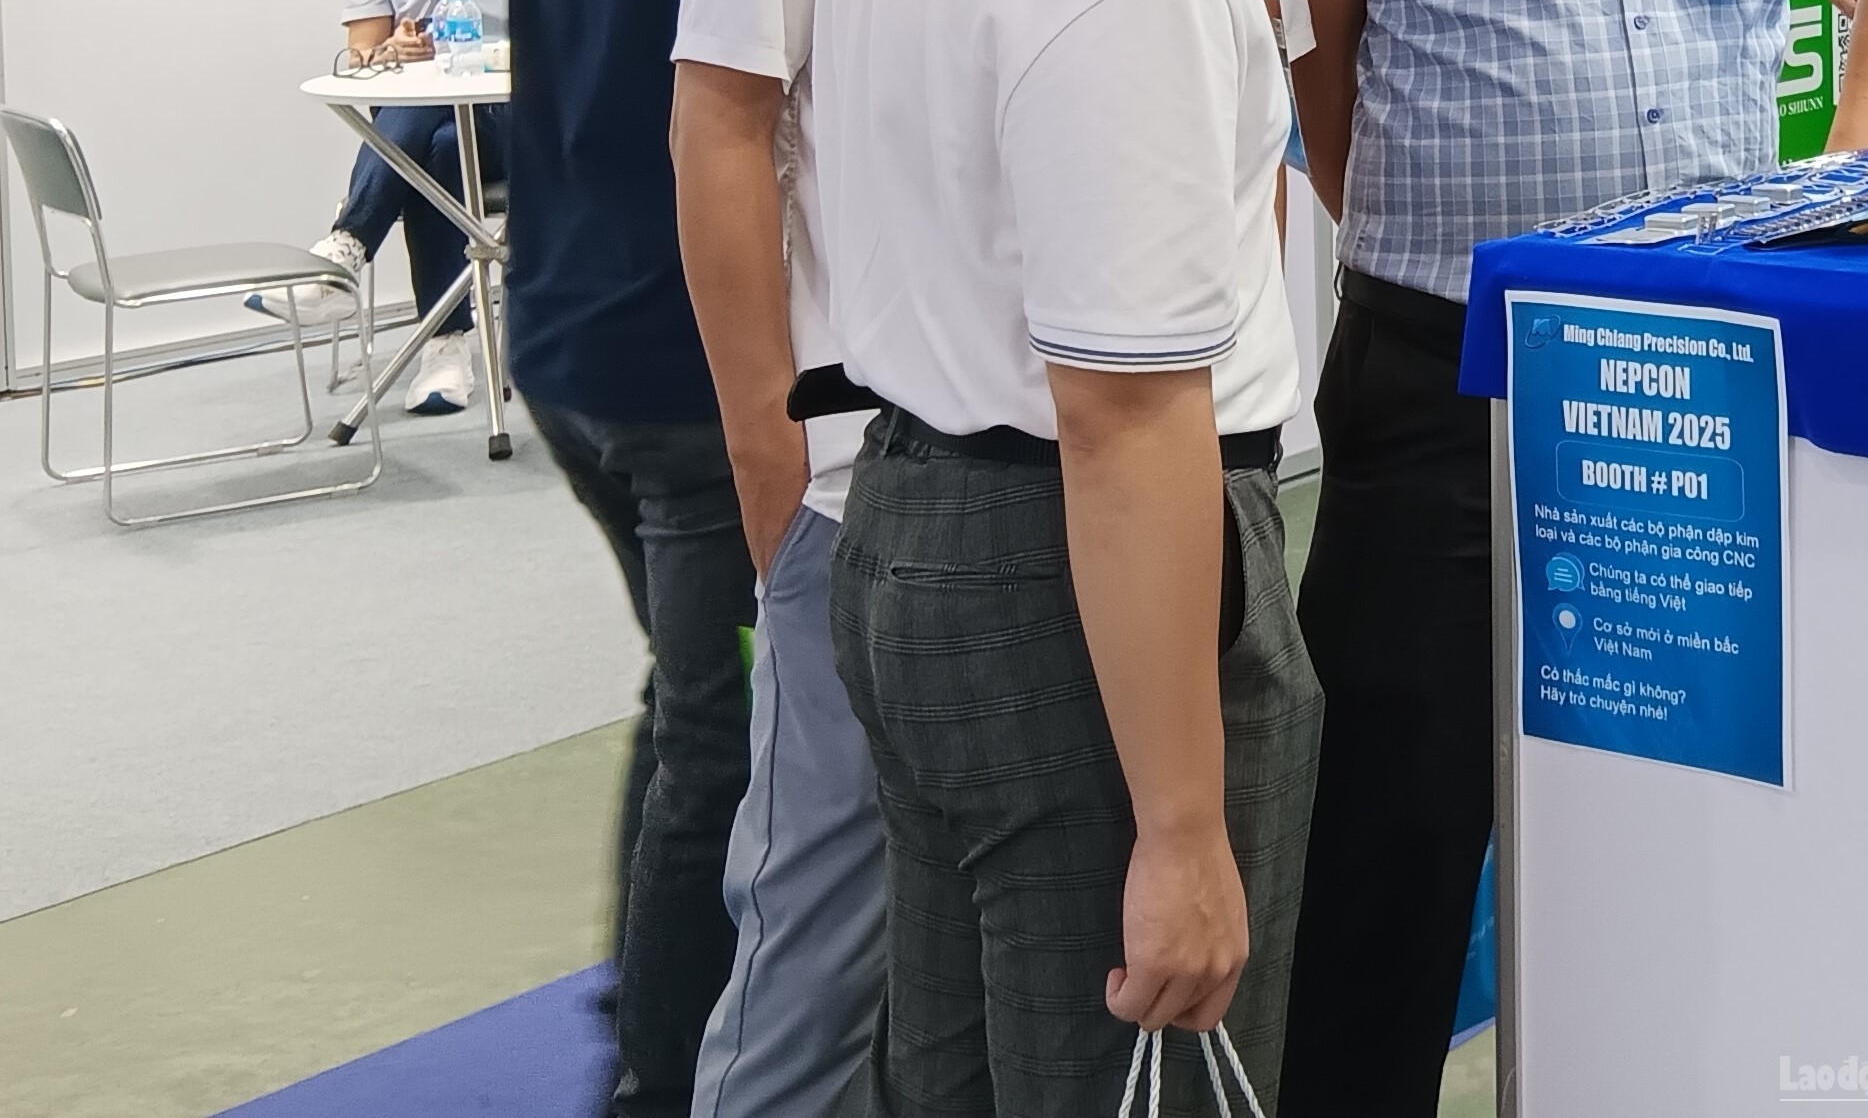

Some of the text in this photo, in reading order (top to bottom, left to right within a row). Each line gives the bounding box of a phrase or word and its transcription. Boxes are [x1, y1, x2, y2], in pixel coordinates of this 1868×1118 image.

[1563, 323, 1595, 347] Ming
[1597, 327, 1641, 352] Chiang
[1643, 332, 1707, 356] Precision
[1732, 342, 1755, 363] Ltd.
[1600, 358, 1691, 400] NEPCON
[1562, 400, 1732, 450] VIETNAM 2025
[1582, 459, 1708, 499] BOOTH # P01
[1535, 524, 1558, 541] loại
[1661, 543, 1682, 560] gia
[1685, 546, 1719, 566] công
[1722, 551, 1756, 568] CNC
[1736, 531, 1760, 548] kim
[1634, 570, 1647, 584] ta
[1695, 578, 1725, 596] giao
[1659, 592, 1687, 612] Việt
[1594, 637, 1653, 660] Việt Nam
